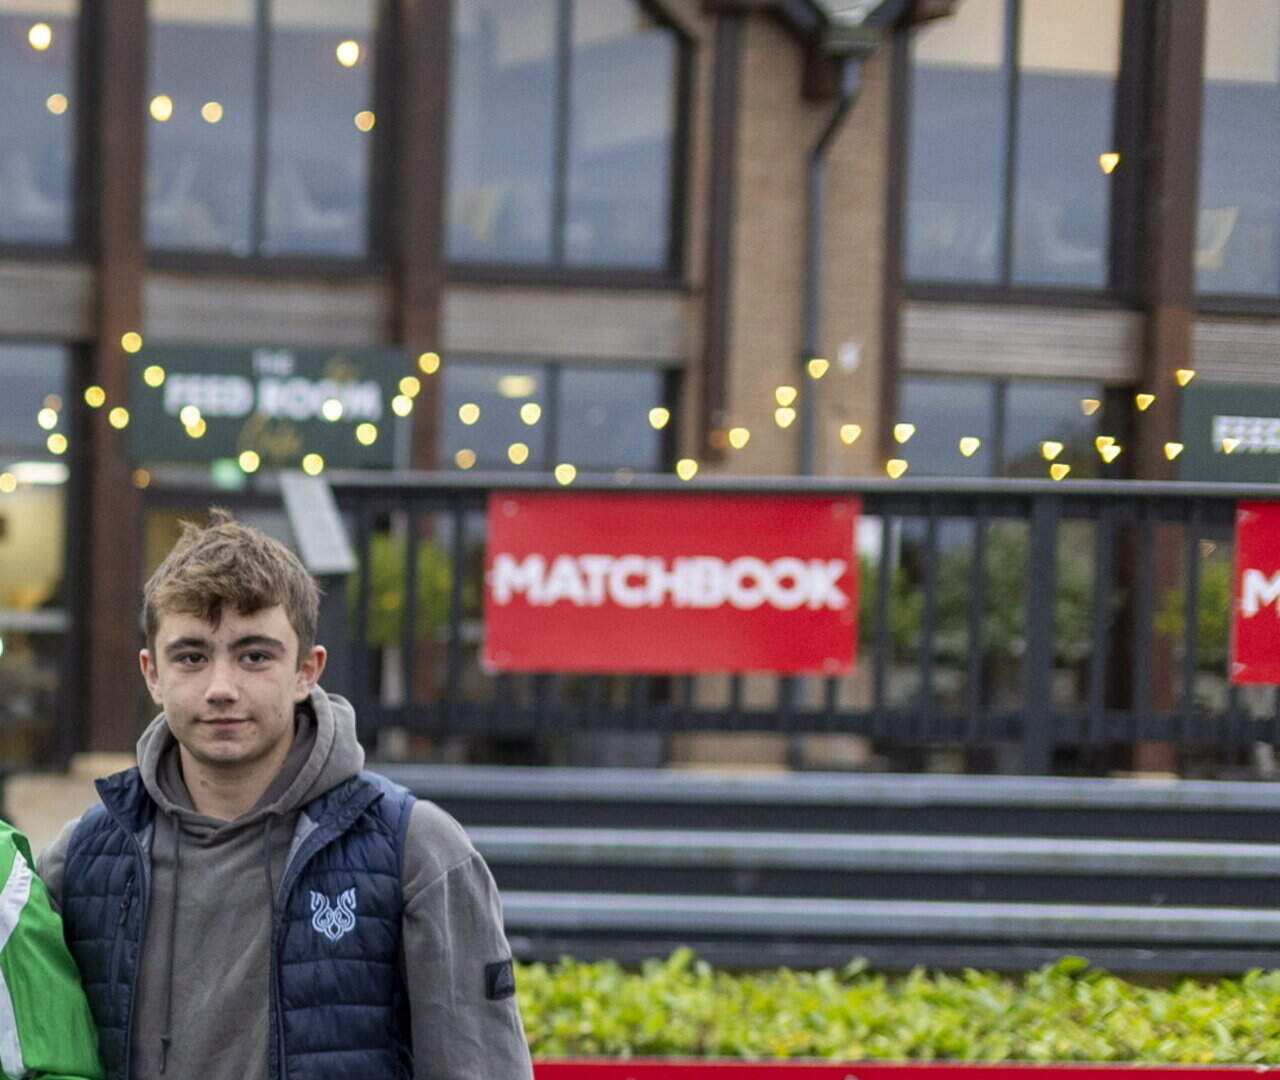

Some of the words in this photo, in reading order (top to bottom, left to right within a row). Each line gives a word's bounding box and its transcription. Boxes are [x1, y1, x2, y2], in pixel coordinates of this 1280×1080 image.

[165, 374, 254, 417] FEED
[257, 377, 382, 422] ROOM
[492, 553, 849, 611] MATCHBOOK
